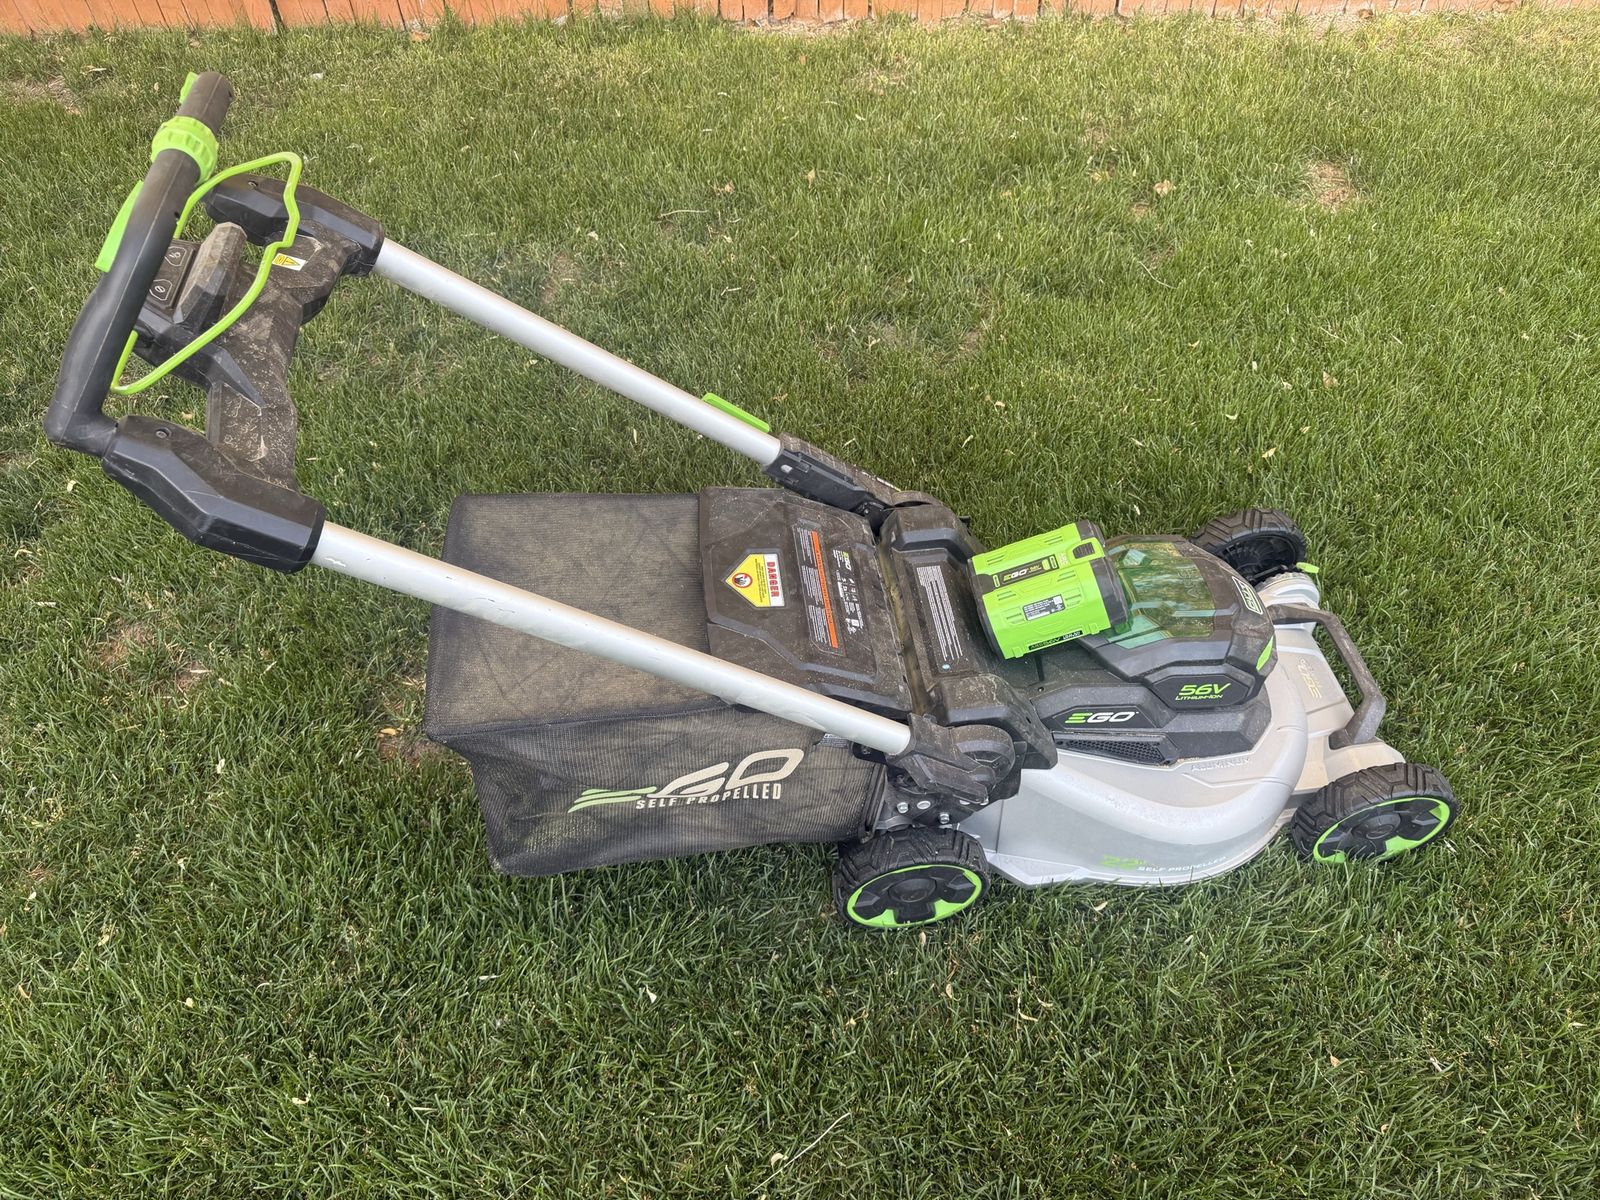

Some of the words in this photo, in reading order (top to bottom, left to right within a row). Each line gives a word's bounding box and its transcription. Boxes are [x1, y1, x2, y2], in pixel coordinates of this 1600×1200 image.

[766, 561, 780, 598] DANGER
[1003, 569, 1027, 582] EGO
[1178, 682, 1231, 696] 56V
[1064, 711, 1136, 724] EGO
[635, 798, 677, 810] SELF
[686, 783, 781, 805] PROPELLED
